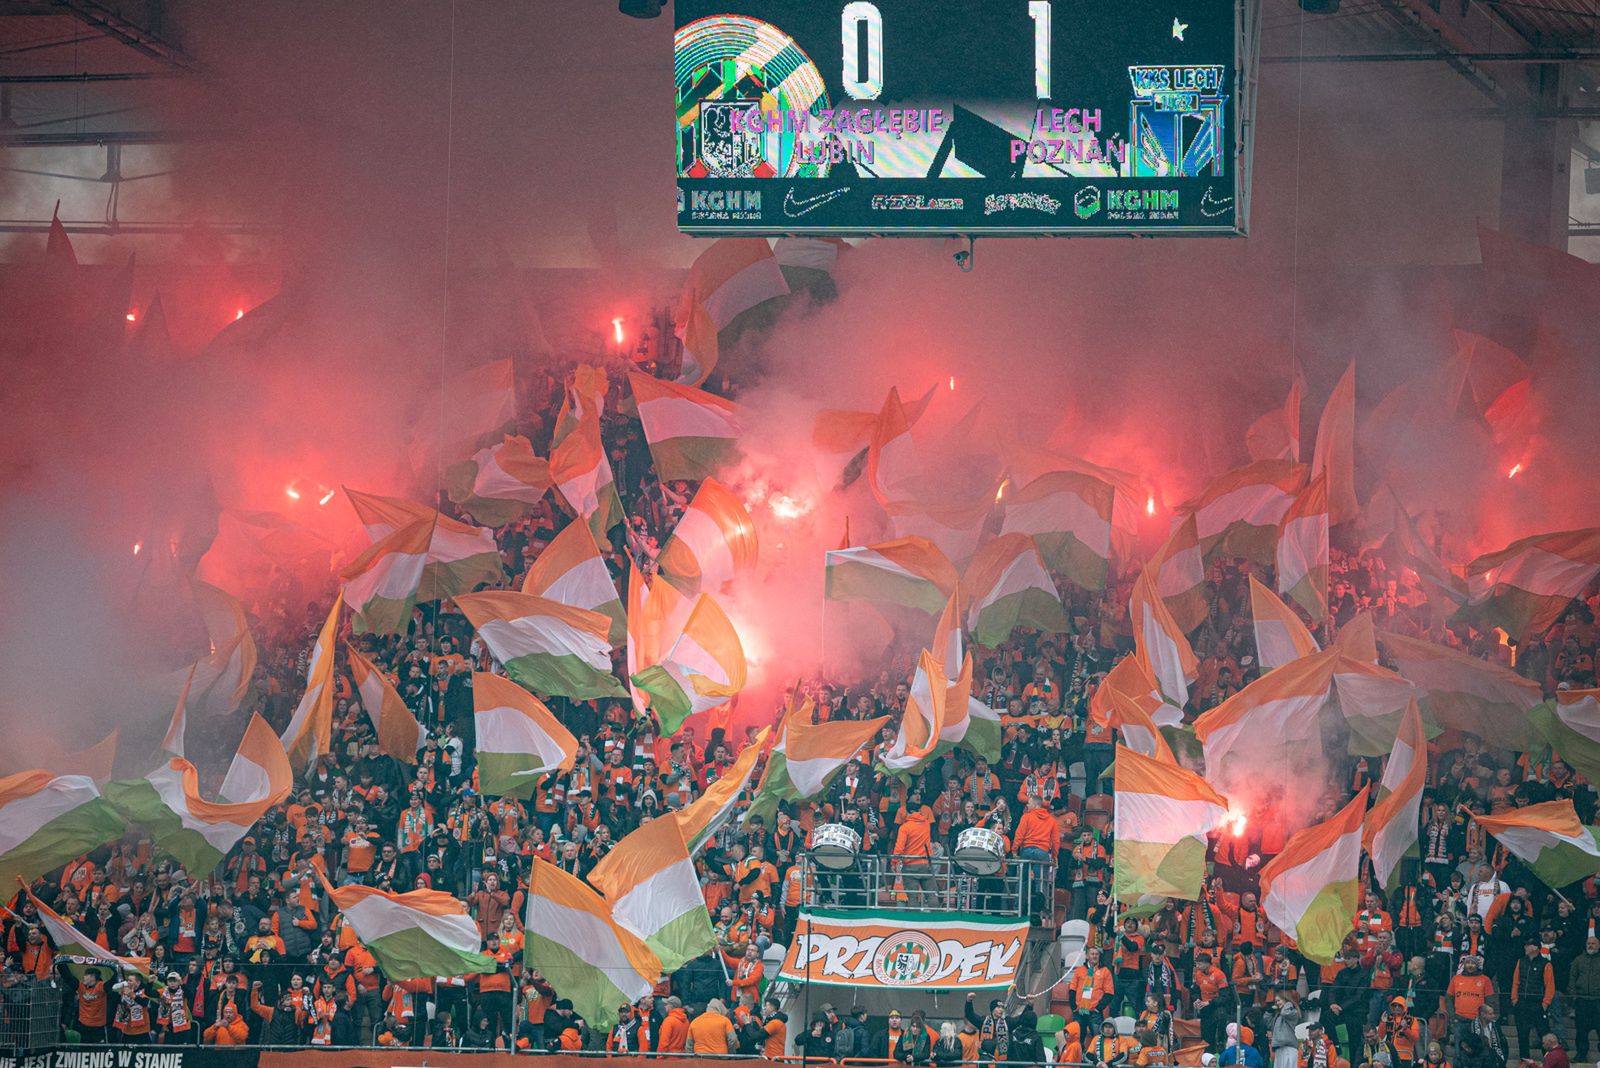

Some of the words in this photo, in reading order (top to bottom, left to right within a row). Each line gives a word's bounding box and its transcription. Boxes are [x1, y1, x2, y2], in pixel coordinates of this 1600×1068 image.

[841, 1, 883, 100] 0
[1028, 0, 1051, 99] 1
[1136, 68, 1170, 89] KKS
[1174, 68, 1217, 89] LECH
[730, 109, 810, 133] KGHM
[819, 109, 943, 139] ZAGŁĘBIE
[1037, 108, 1102, 133] LECH
[796, 140, 875, 165] LUBIN
[1010, 132, 1126, 164] POZNAŃ
[691, 190, 762, 210] KGHM
[1106, 189, 1179, 210] KGHM
[20, 1051, 54, 1068] JEST
[55, 1049, 114, 1068] ZMIENIĆ
[118, 1050, 132, 1068] W
[134, 1052, 184, 1068] STANIE
